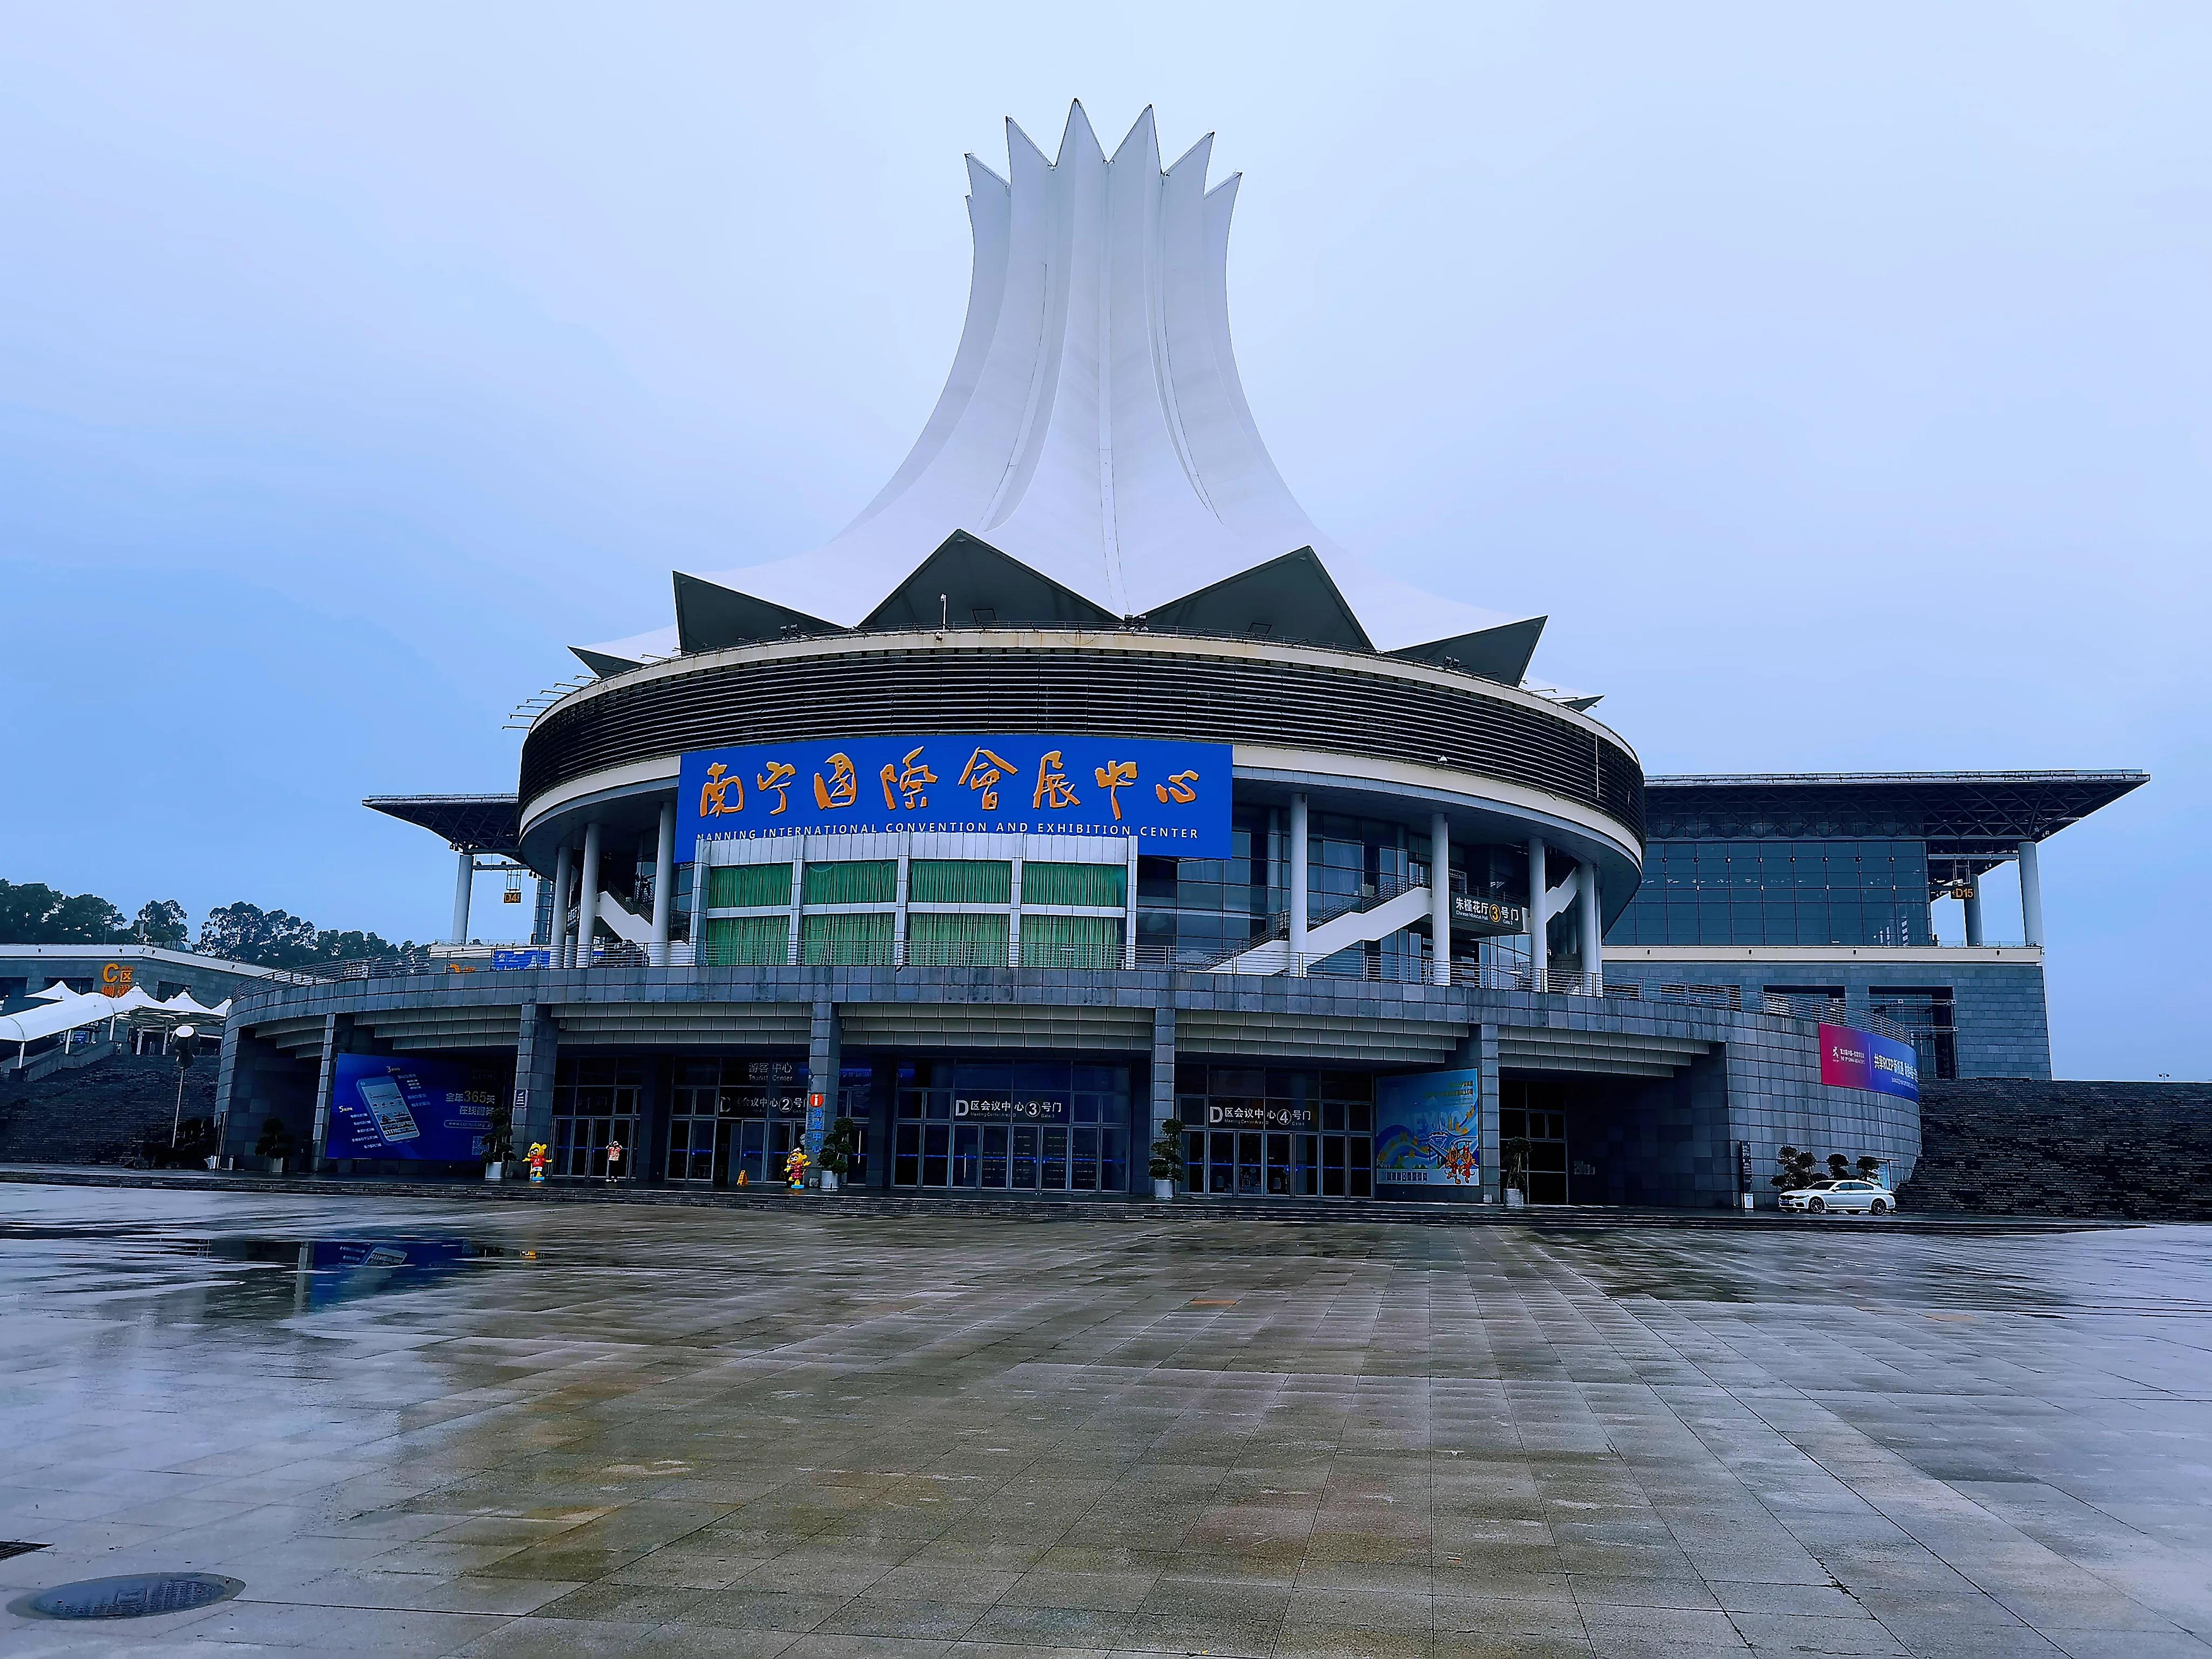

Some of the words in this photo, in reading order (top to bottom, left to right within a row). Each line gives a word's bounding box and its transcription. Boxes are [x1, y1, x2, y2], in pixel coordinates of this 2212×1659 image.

[697, 830, 756, 840] NANNING
[764, 824, 877, 838] INTERNATIONAL
[886, 822, 987, 833] CONVENTION
[996, 822, 1028, 832] AND
[1037, 824, 1130, 835] EXHIBITION
[1141, 826, 1198, 839] CENTER
[1956, 888, 1973, 897] D15
[103, 963, 132, 982] C区
[749, 1062, 792, 1073] 游客中心
[446, 1090, 495, 1104] 全年365天
